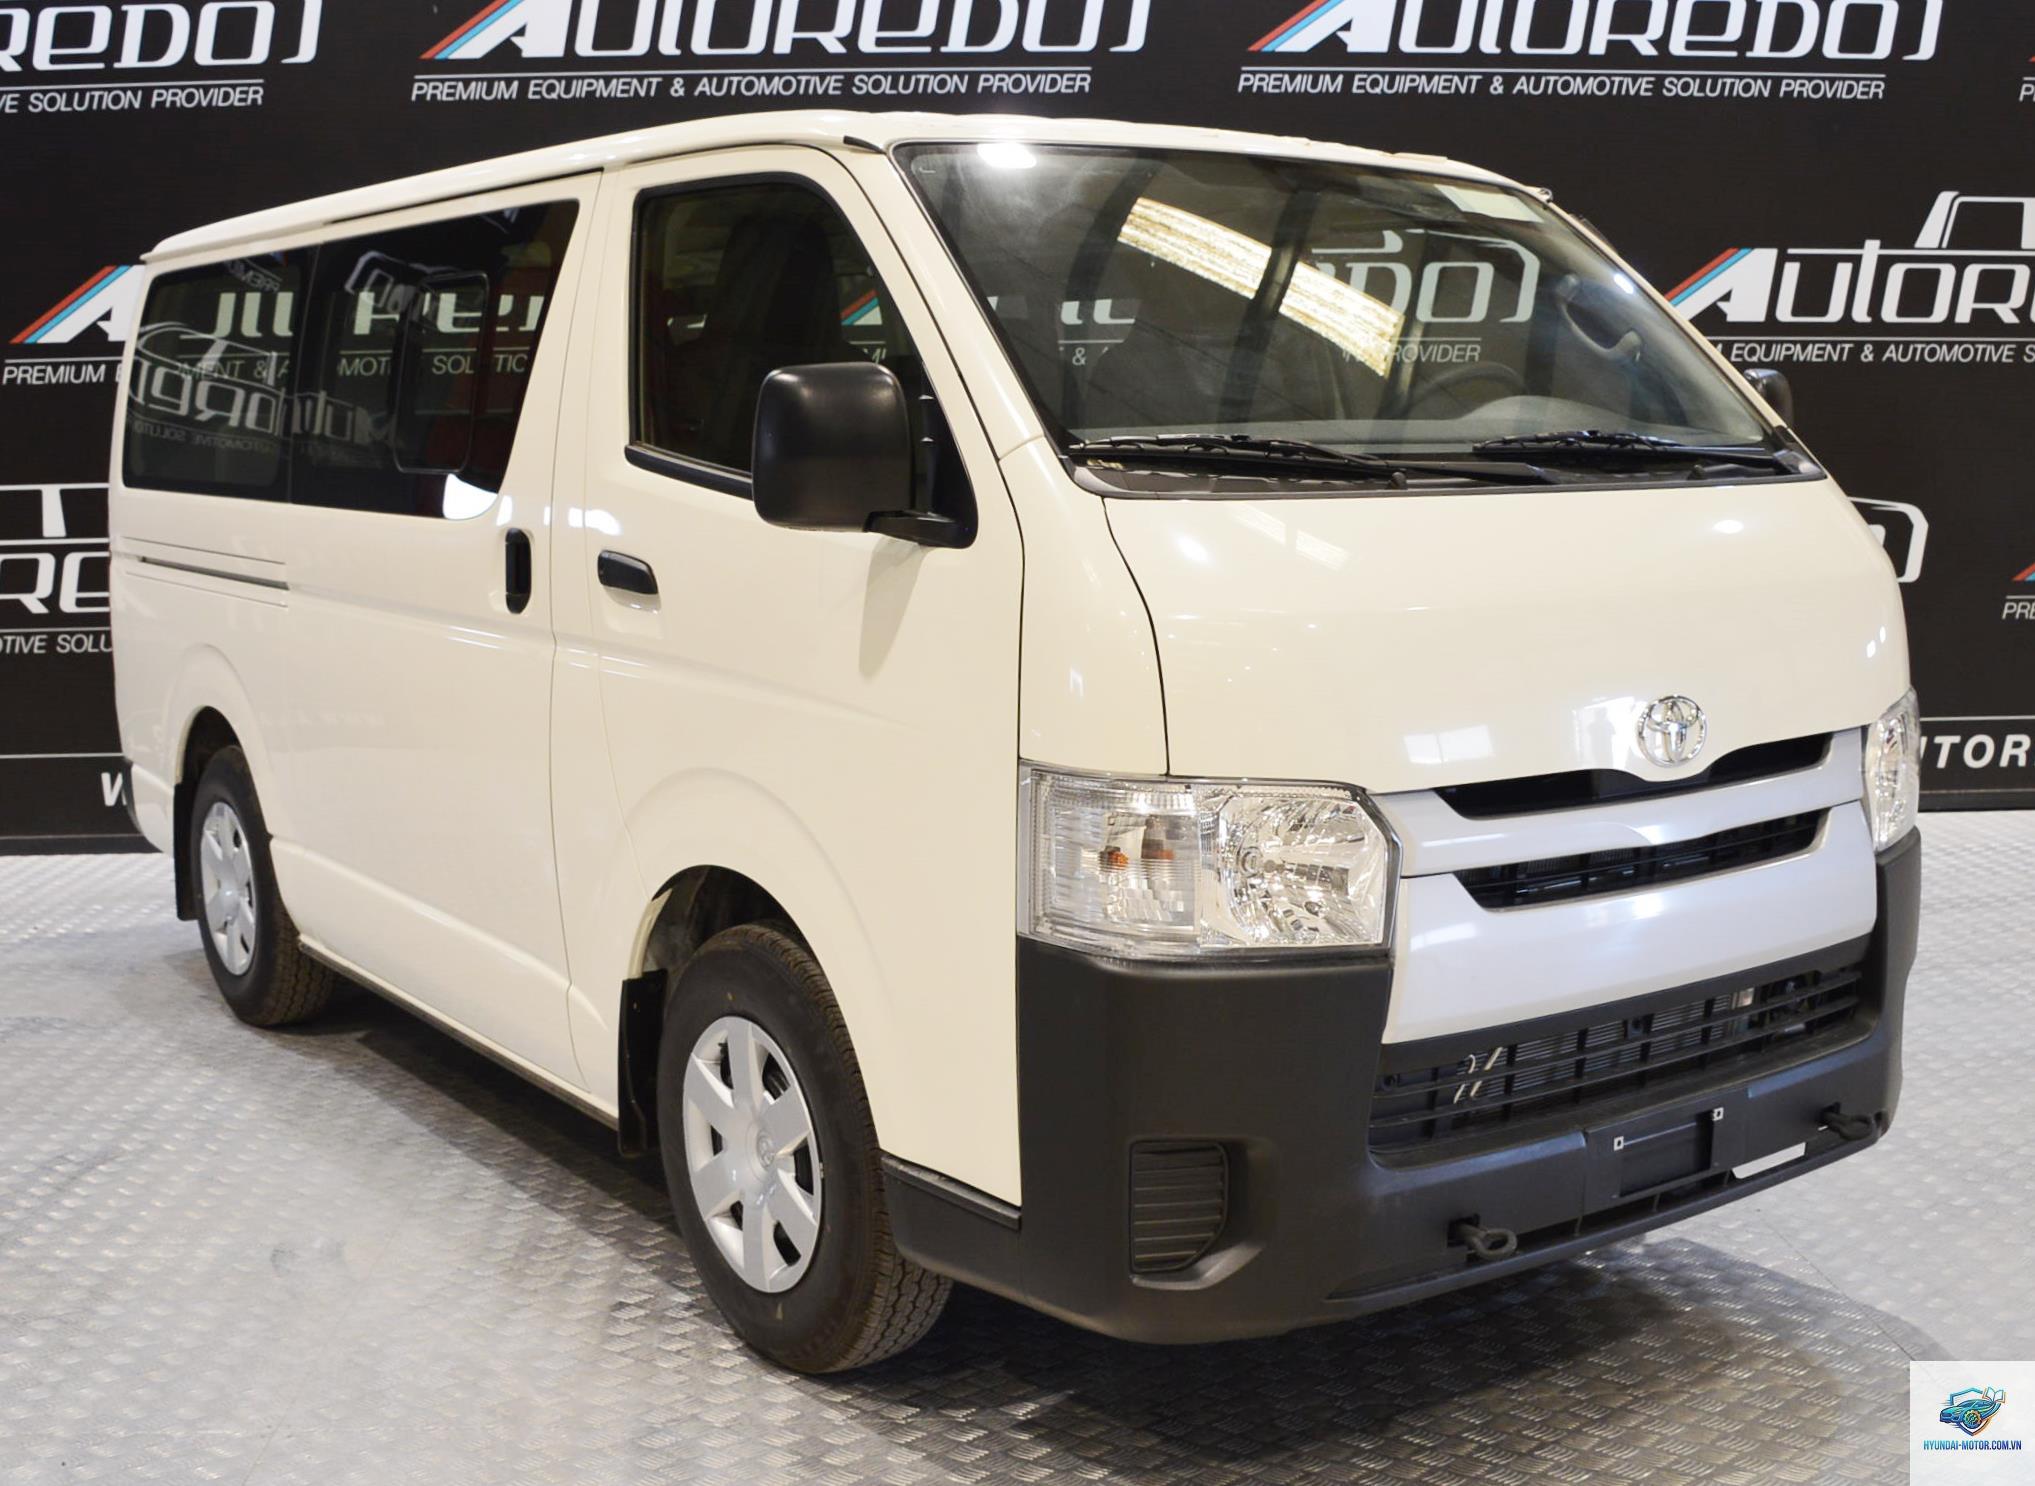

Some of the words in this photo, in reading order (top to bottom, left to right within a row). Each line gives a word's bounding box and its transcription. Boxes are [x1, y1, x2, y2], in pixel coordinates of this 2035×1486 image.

[28, 89, 143, 113] SOLUTION
[151, 86, 264, 109] PROVIDER
[411, 79, 519, 102] PREMIUM
[528, 77, 663, 100] EQUIPMENT
[669, 77, 685, 98] &
[693, 75, 845, 97] AUTOMOTIVE
[852, 74, 969, 95] SOLUTION
[977, 73, 1092, 94] PROVIDER
[1237, 73, 1344, 94] PREMIUM
[1351, 74, 1483, 95] EQUIPMENT
[1489, 75, 1504, 95] &
[1512, 76, 1656, 97] AUTOMOTIVE
[1662, 77, 1772, 98] SOLUTION
[1779, 78, 1886, 100] PROVIDER
[1730, 343, 1854, 364] EQUIPMENT
[1860, 343, 1874, 363] &
[1882, 343, 2017, 363] AUTOMOTIVE
[2, 363, 106, 385] PREMIUM
